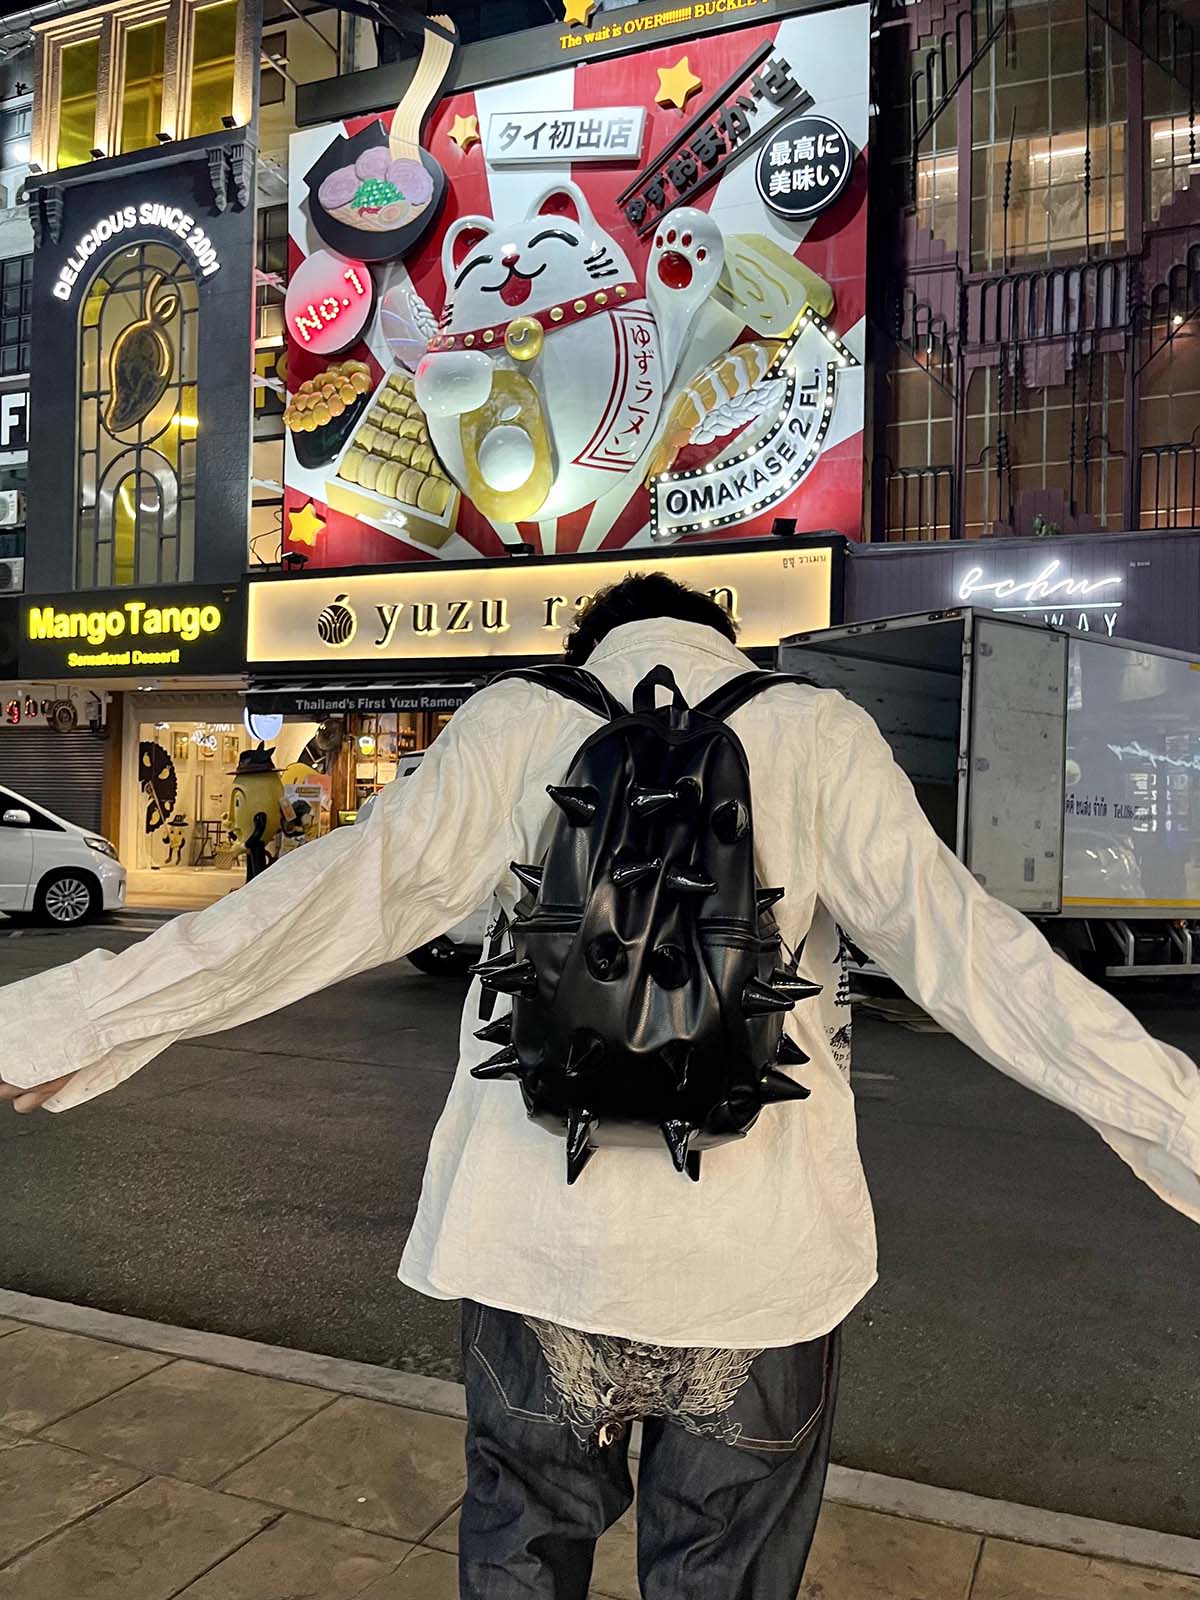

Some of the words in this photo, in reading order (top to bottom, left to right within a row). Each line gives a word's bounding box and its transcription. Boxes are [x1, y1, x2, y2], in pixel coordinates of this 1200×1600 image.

[560, 34, 582, 48] The
[584, 27, 610, 42] wait
[612, 24, 622, 37] is
[498, 118, 634, 151] タイ初出店
[623, 58, 803, 226] ゆずおまかせ
[769, 133, 840, 167] 最高に
[769, 164, 840, 197] 美味い
[52, 206, 138, 301] DELICIOUS
[138, 203, 196, 239] SINCE
[185, 227, 222, 277] 2001
[604, 324, 654, 456] ゆずラーメン
[666, 441, 797, 515] OMAKASE
[789, 417, 813, 440] 2
[373, 597, 511, 649] yuzu
[296, 699, 355, 710] Thailand's
[357, 698, 386, 709] First
[389, 698, 418, 709] Yuzu
[420, 697, 463, 708] Ramen
